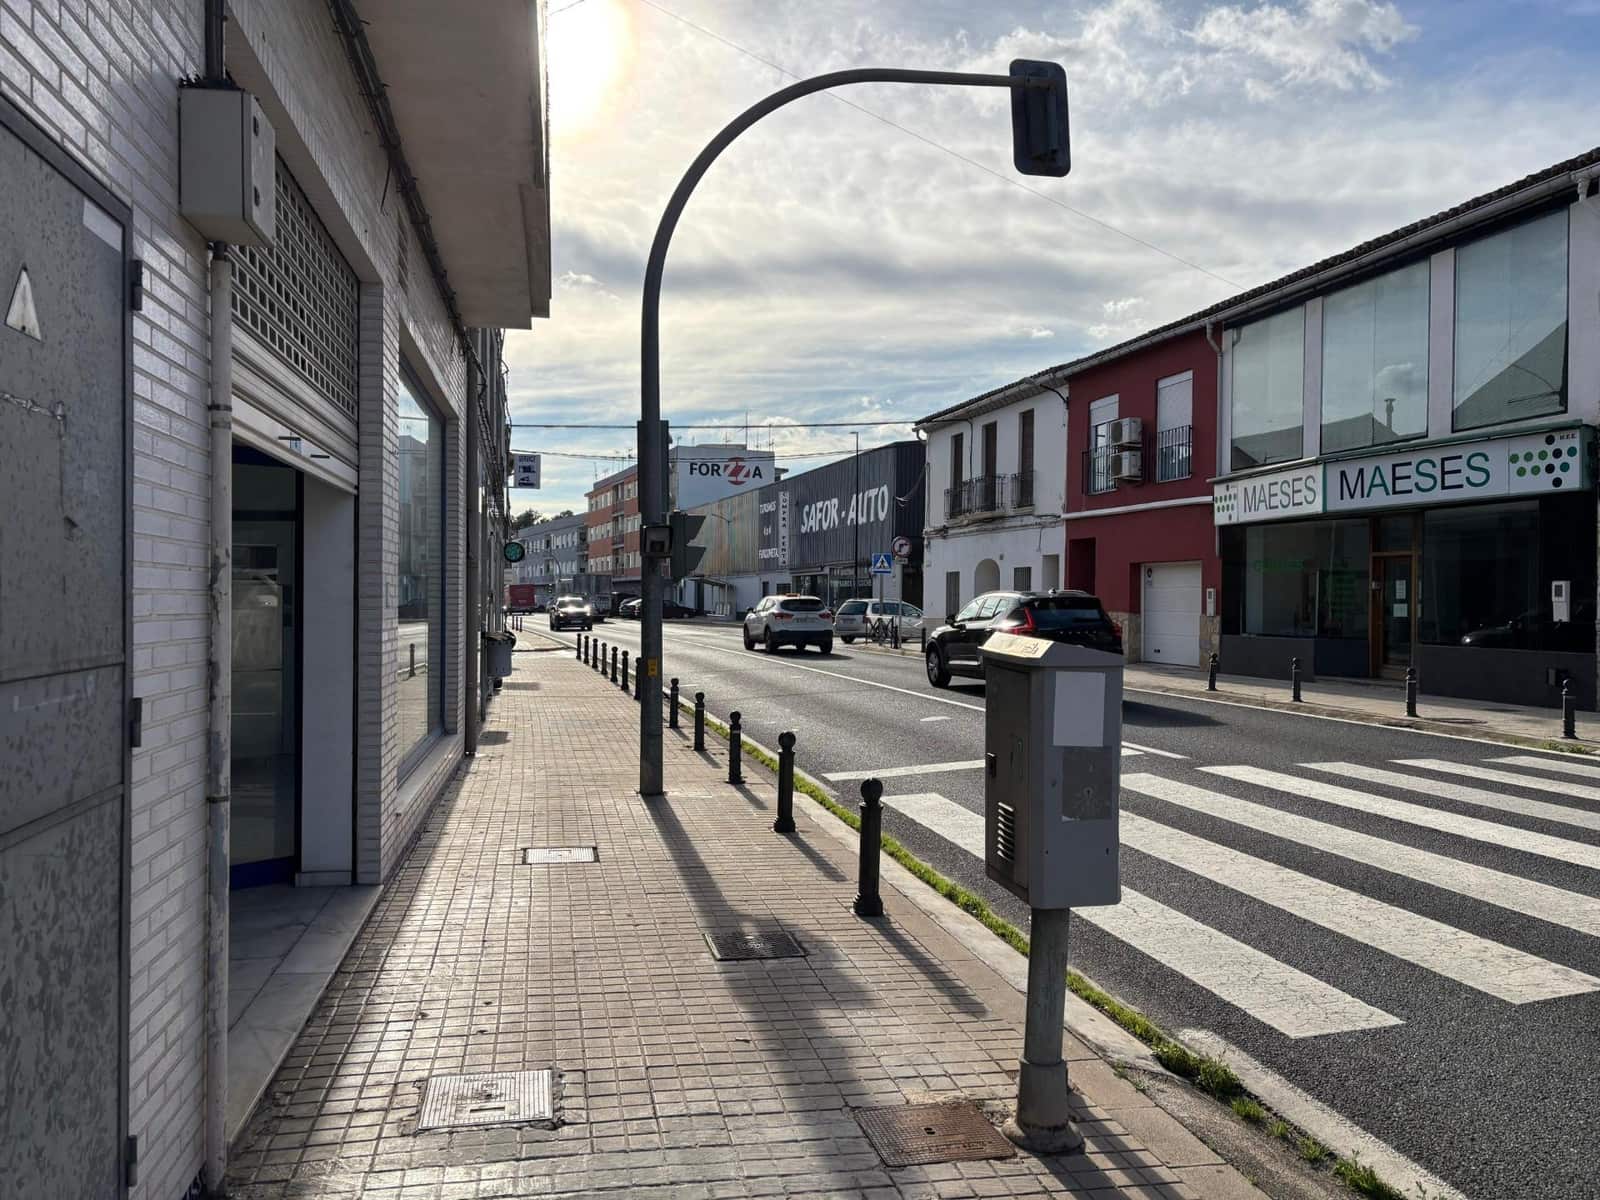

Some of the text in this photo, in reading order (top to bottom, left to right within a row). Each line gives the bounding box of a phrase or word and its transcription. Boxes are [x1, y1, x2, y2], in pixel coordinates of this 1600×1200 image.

[1244, 475, 1317, 513] MAESES
[1339, 452, 1491, 500] MAESES
[801, 497, 839, 533] SAFOR
[847, 484, 888, 526] AUTO
